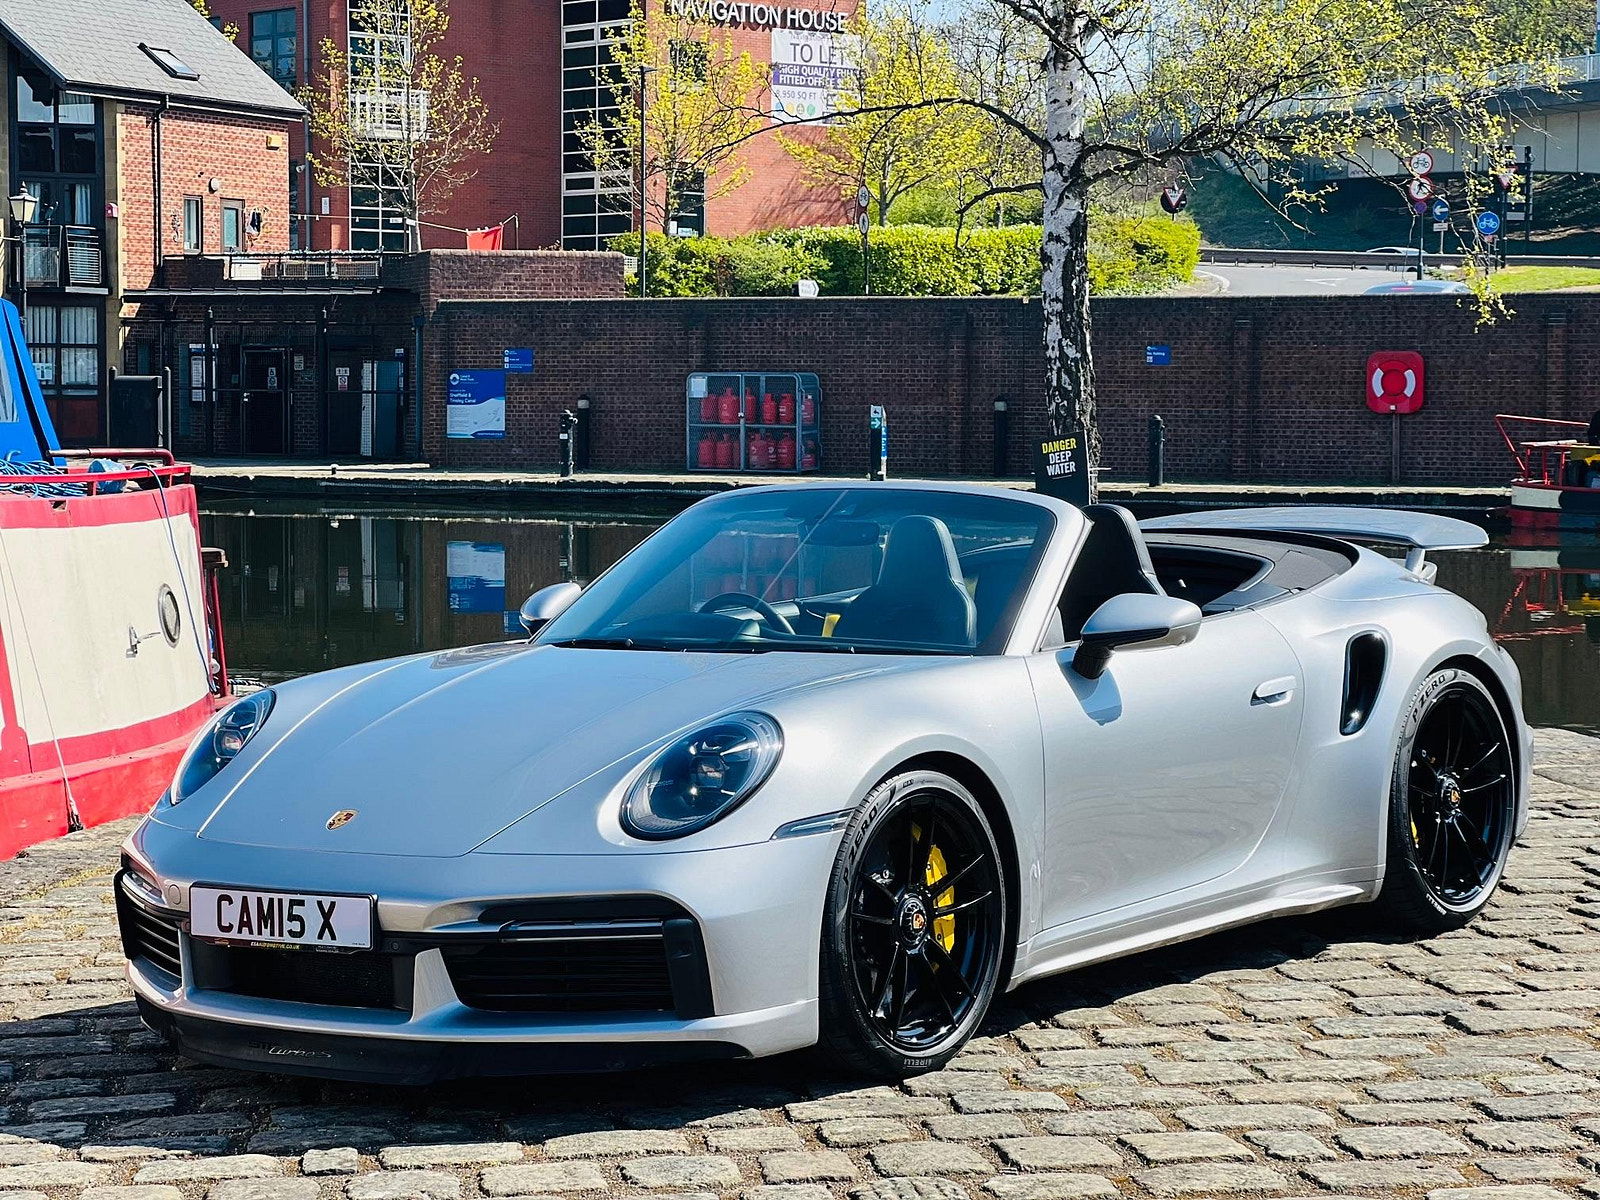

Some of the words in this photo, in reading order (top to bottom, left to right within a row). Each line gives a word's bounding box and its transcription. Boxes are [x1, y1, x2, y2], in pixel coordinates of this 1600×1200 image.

[670, 0, 780, 26] NAVIGATION
[786, 7, 849, 32] HOUSE
[790, 43, 813, 63] TO
[820, 45, 846, 65] LET
[779, 64, 799, 75] HIGH
[801, 65, 836, 78] QUALITY
[779, 74, 807, 85] FITTED
[797, 90, 807, 100] SQ
[809, 92, 816, 100] FT
[1041, 438, 1077, 454] DANGER
[1049, 450, 1072, 464] DEEP
[1046, 461, 1076, 476] WATER
[1419, 674, 1446, 708] ZERO
[848, 805, 877, 865] ZERO
[316, 900, 337, 941] X
